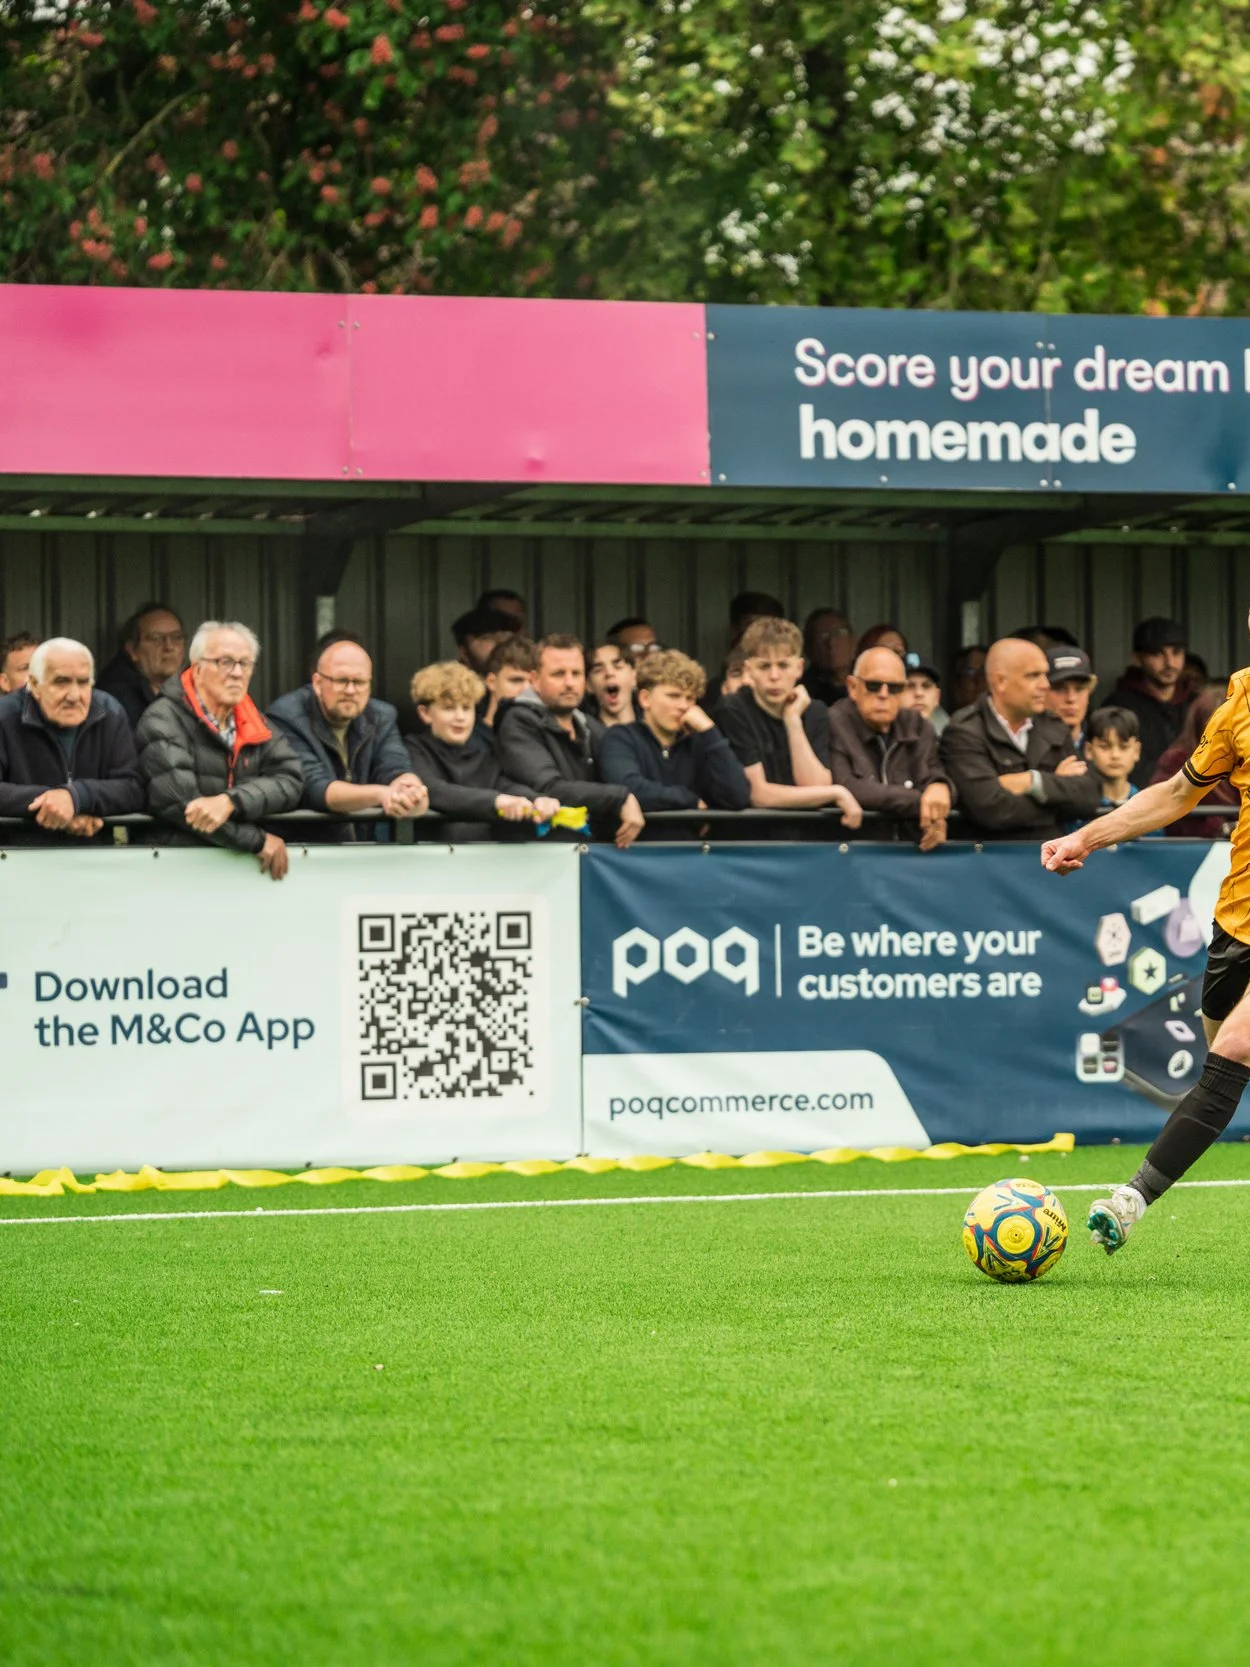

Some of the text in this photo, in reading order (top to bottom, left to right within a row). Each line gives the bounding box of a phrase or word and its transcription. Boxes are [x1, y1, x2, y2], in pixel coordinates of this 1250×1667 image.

[795, 338, 935, 387] Score
[950, 352, 1061, 400] your
[1074, 345, 1229, 392] dream
[800, 404, 1136, 463] homemade
[613, 927, 759, 997] poq
[799, 924, 1042, 965] Be where your
[36, 968, 228, 1001] Download
[799, 969, 1042, 1000] customers are
[35, 1012, 315, 1049] the M&Co App
[610, 1091, 873, 1120] poqcommerce.com
